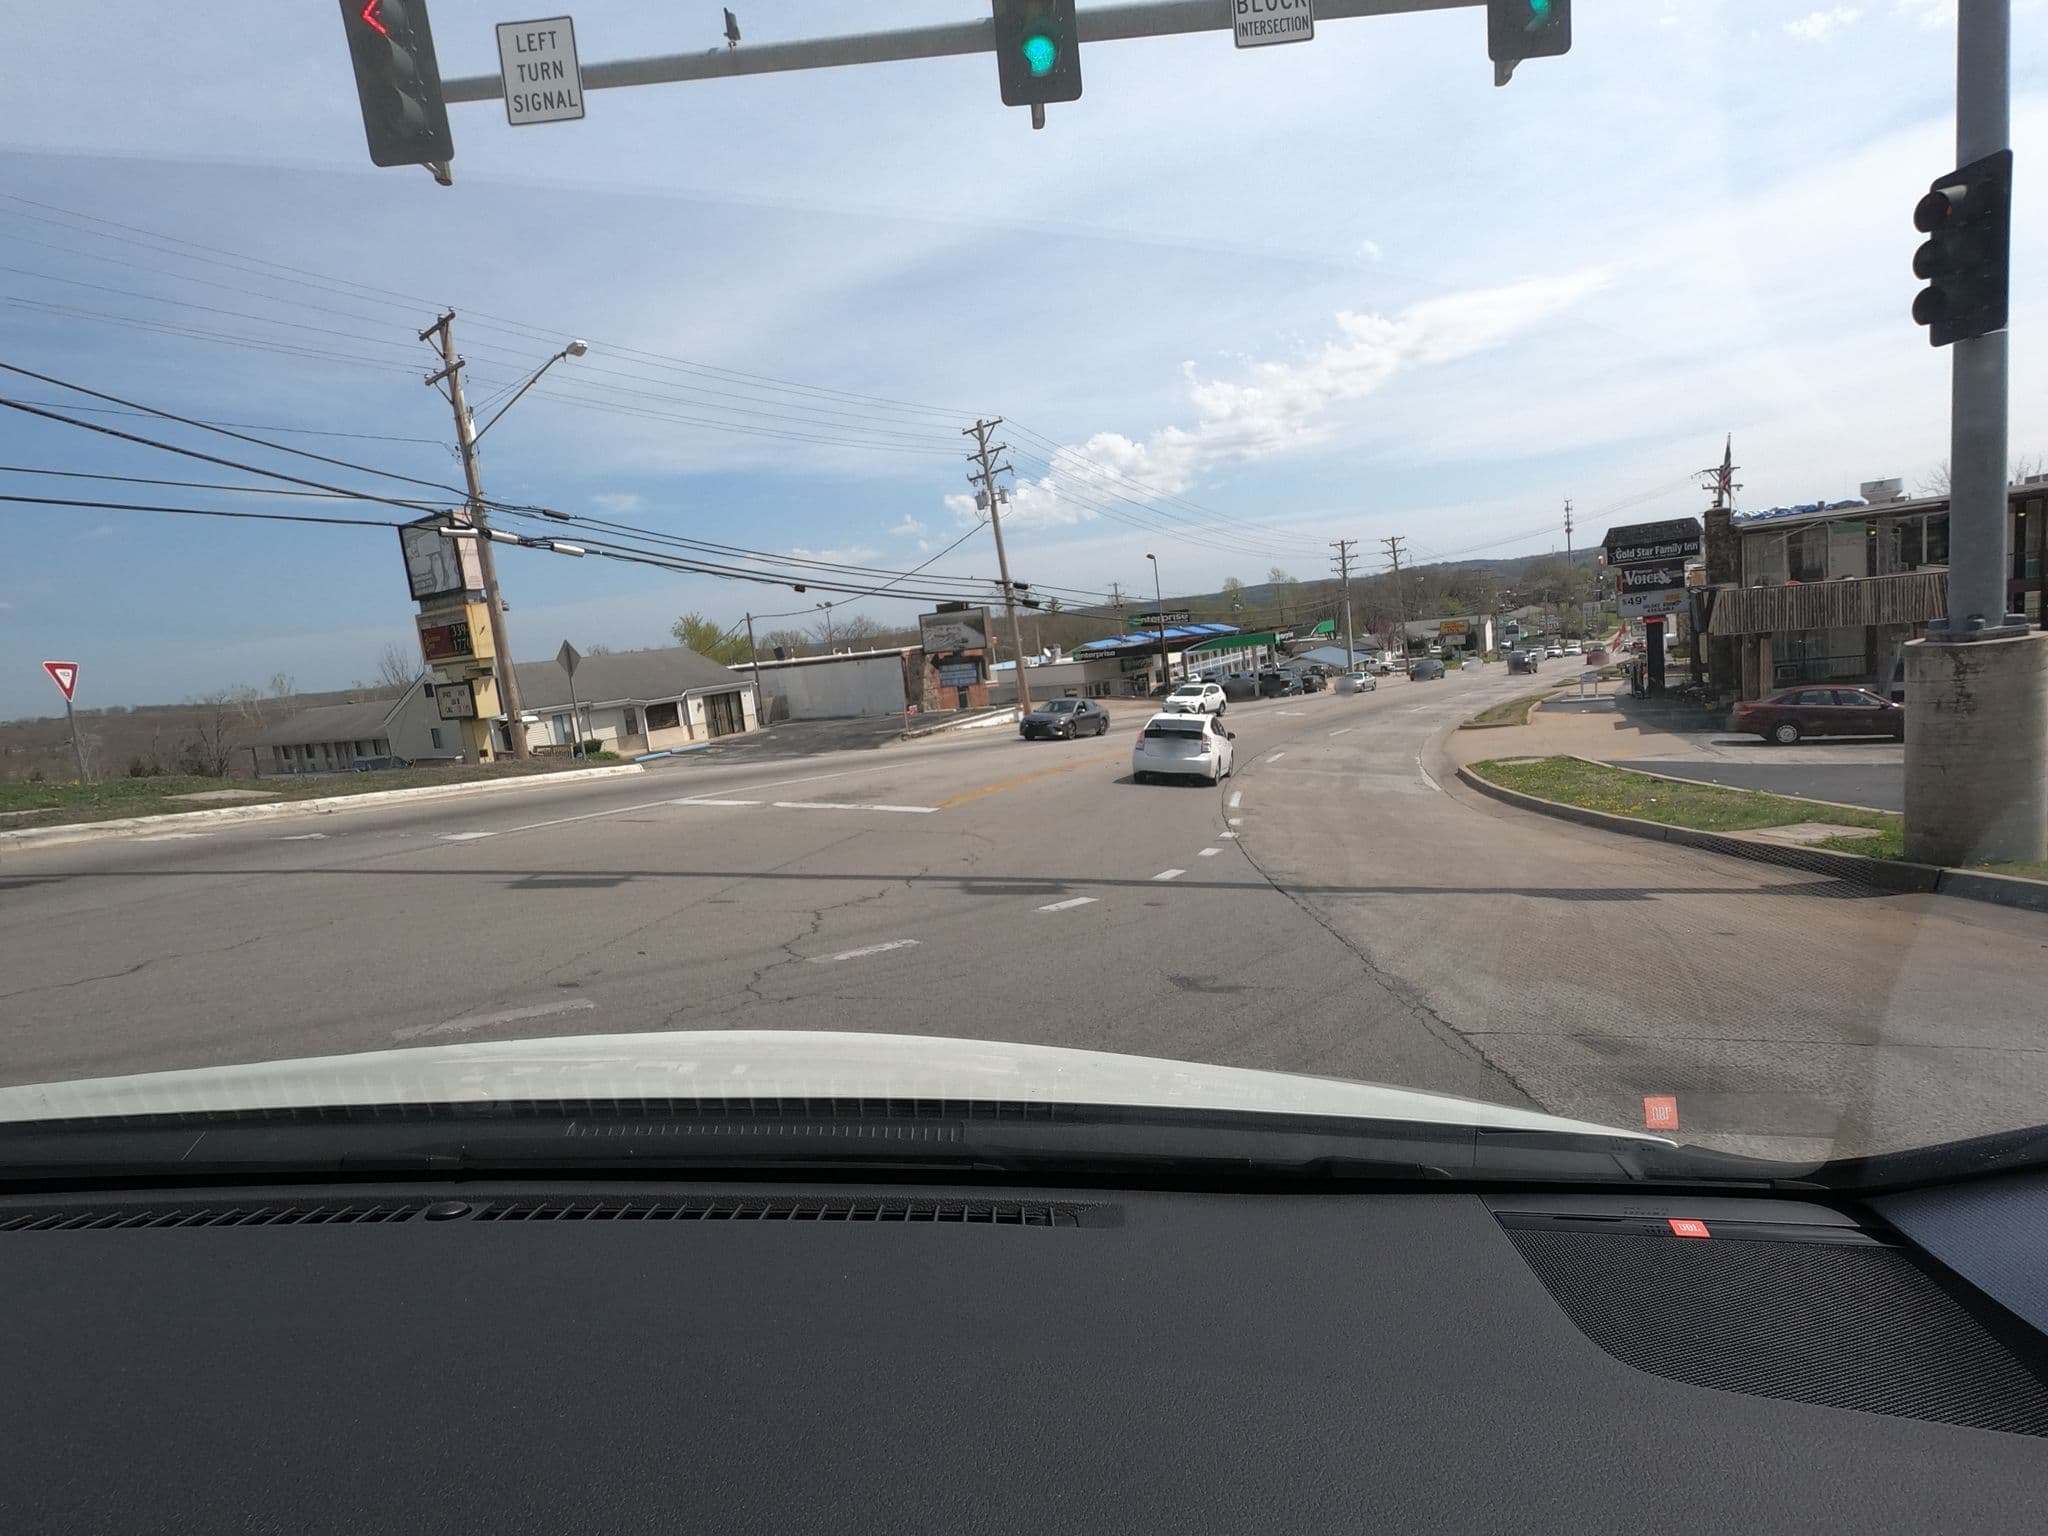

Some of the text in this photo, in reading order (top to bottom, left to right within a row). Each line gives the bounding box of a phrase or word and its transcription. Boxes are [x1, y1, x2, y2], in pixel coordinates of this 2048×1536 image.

[1238, 15, 1309, 38] INTERSECTION
[515, 31, 557, 53] LEFT
[517, 60, 564, 83] TURN
[513, 88, 578, 113] SIGNAL
[1616, 548, 1635, 560] Gold
[1637, 547, 1653, 556] Star
[1655, 543, 1682, 555] Family
[1684, 542, 1698, 551] Inn
